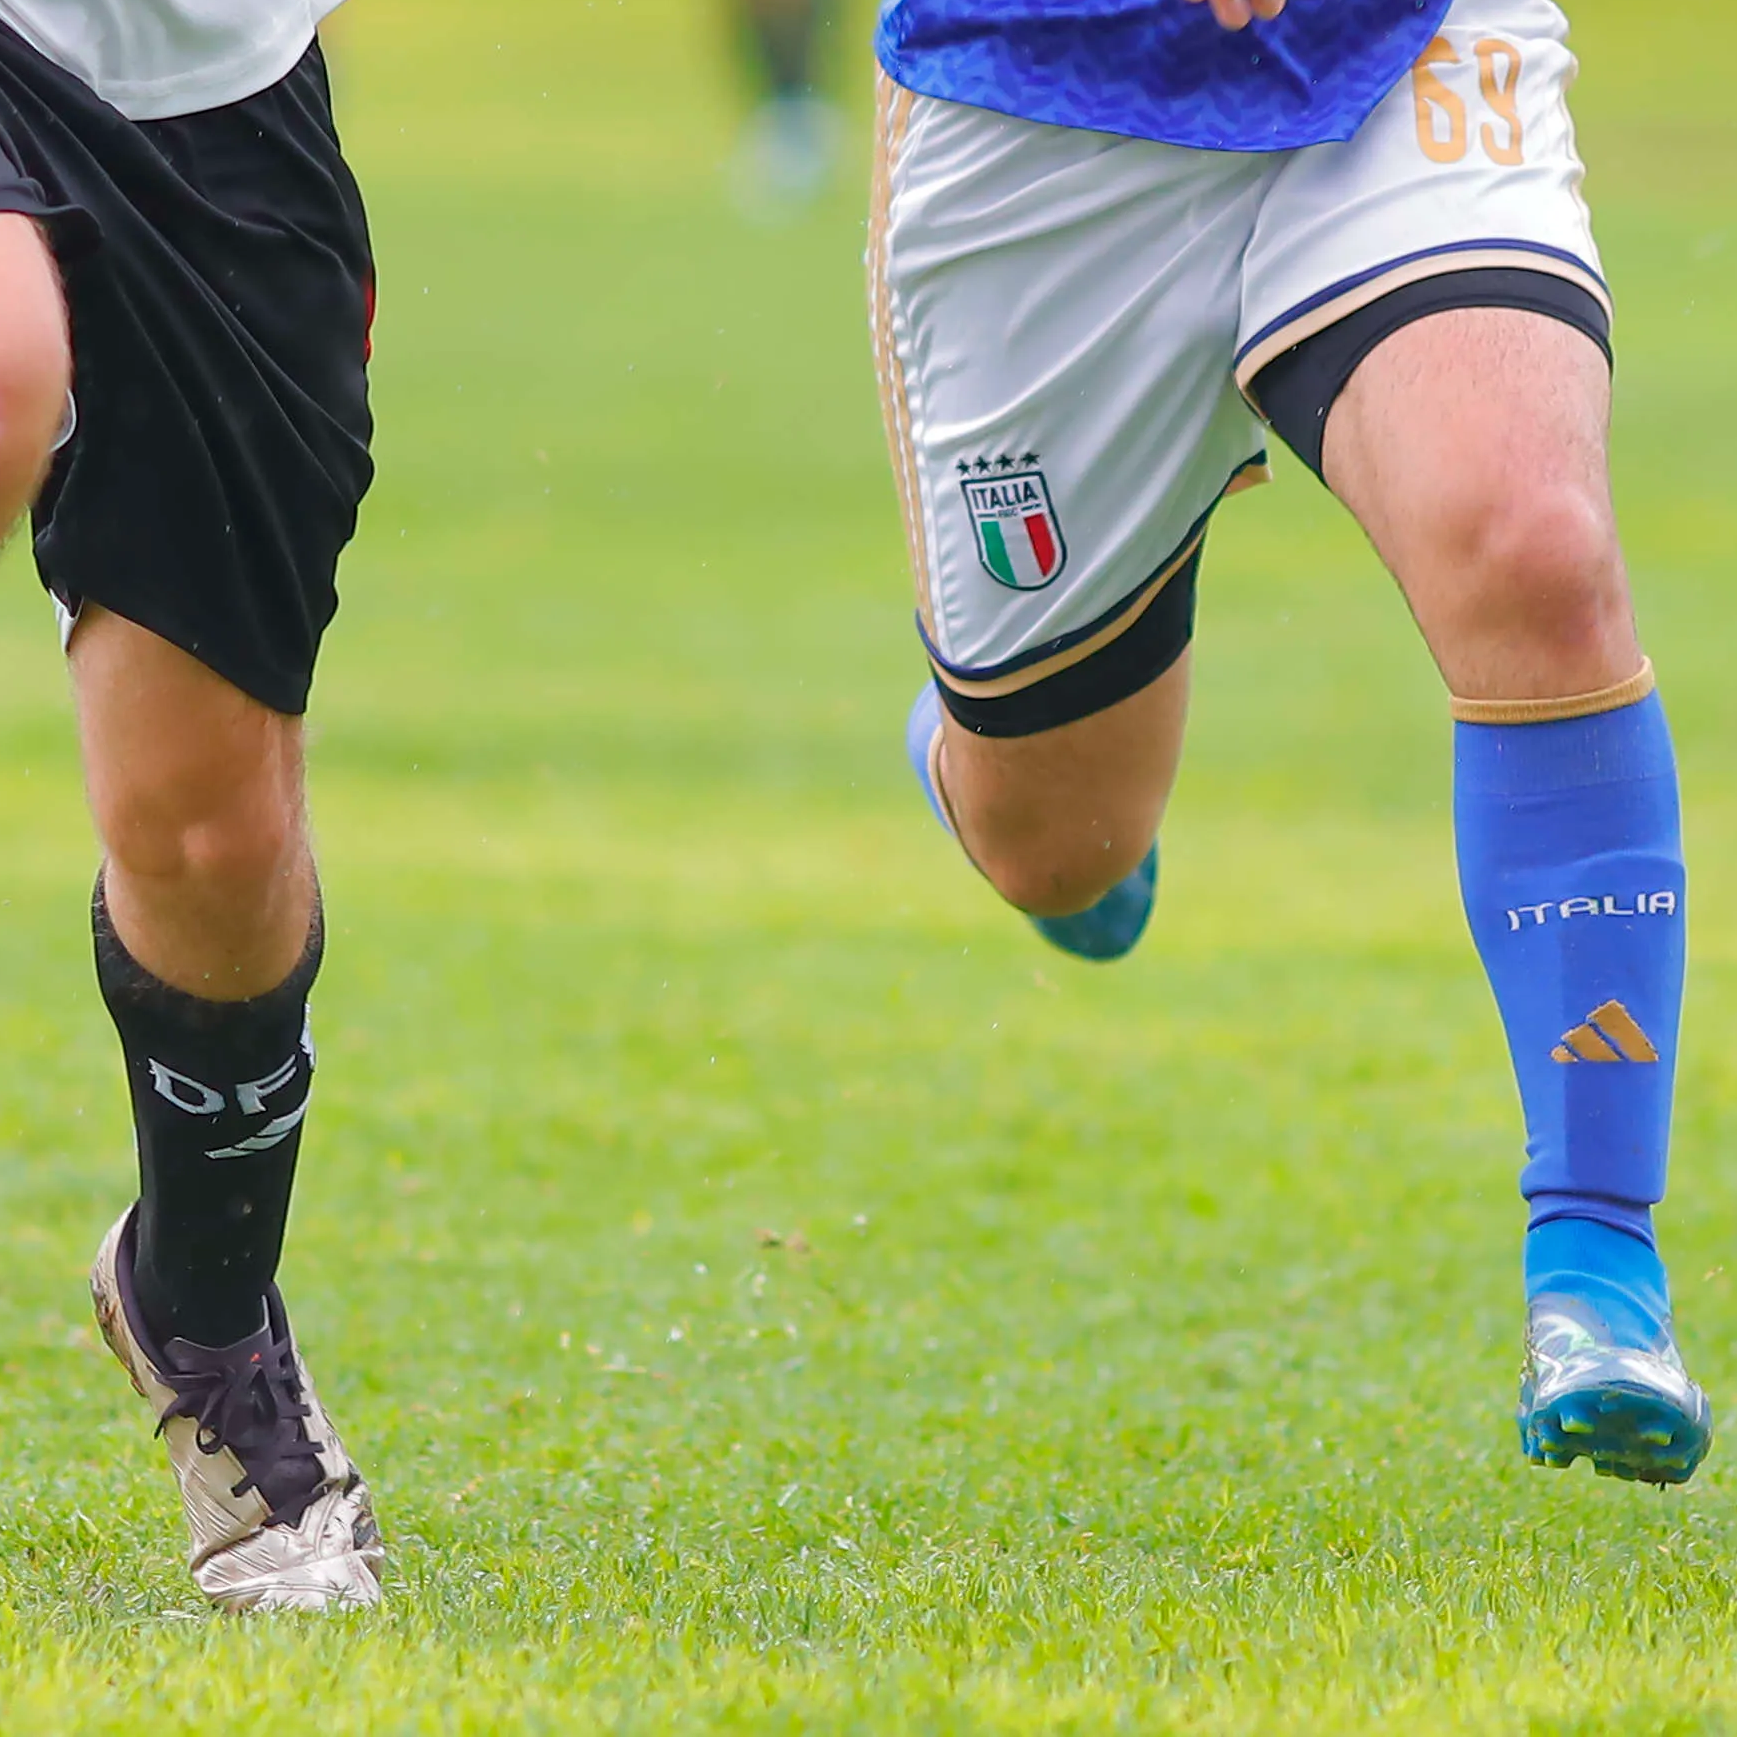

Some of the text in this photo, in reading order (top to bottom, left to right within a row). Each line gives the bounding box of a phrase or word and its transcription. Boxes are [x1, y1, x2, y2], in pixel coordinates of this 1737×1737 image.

[1411, 35, 1525, 166] 69
[971, 480, 1040, 510] ITALIA
[1506, 890, 1676, 932] ITALIA
[148, 1003, 317, 1116] DF
